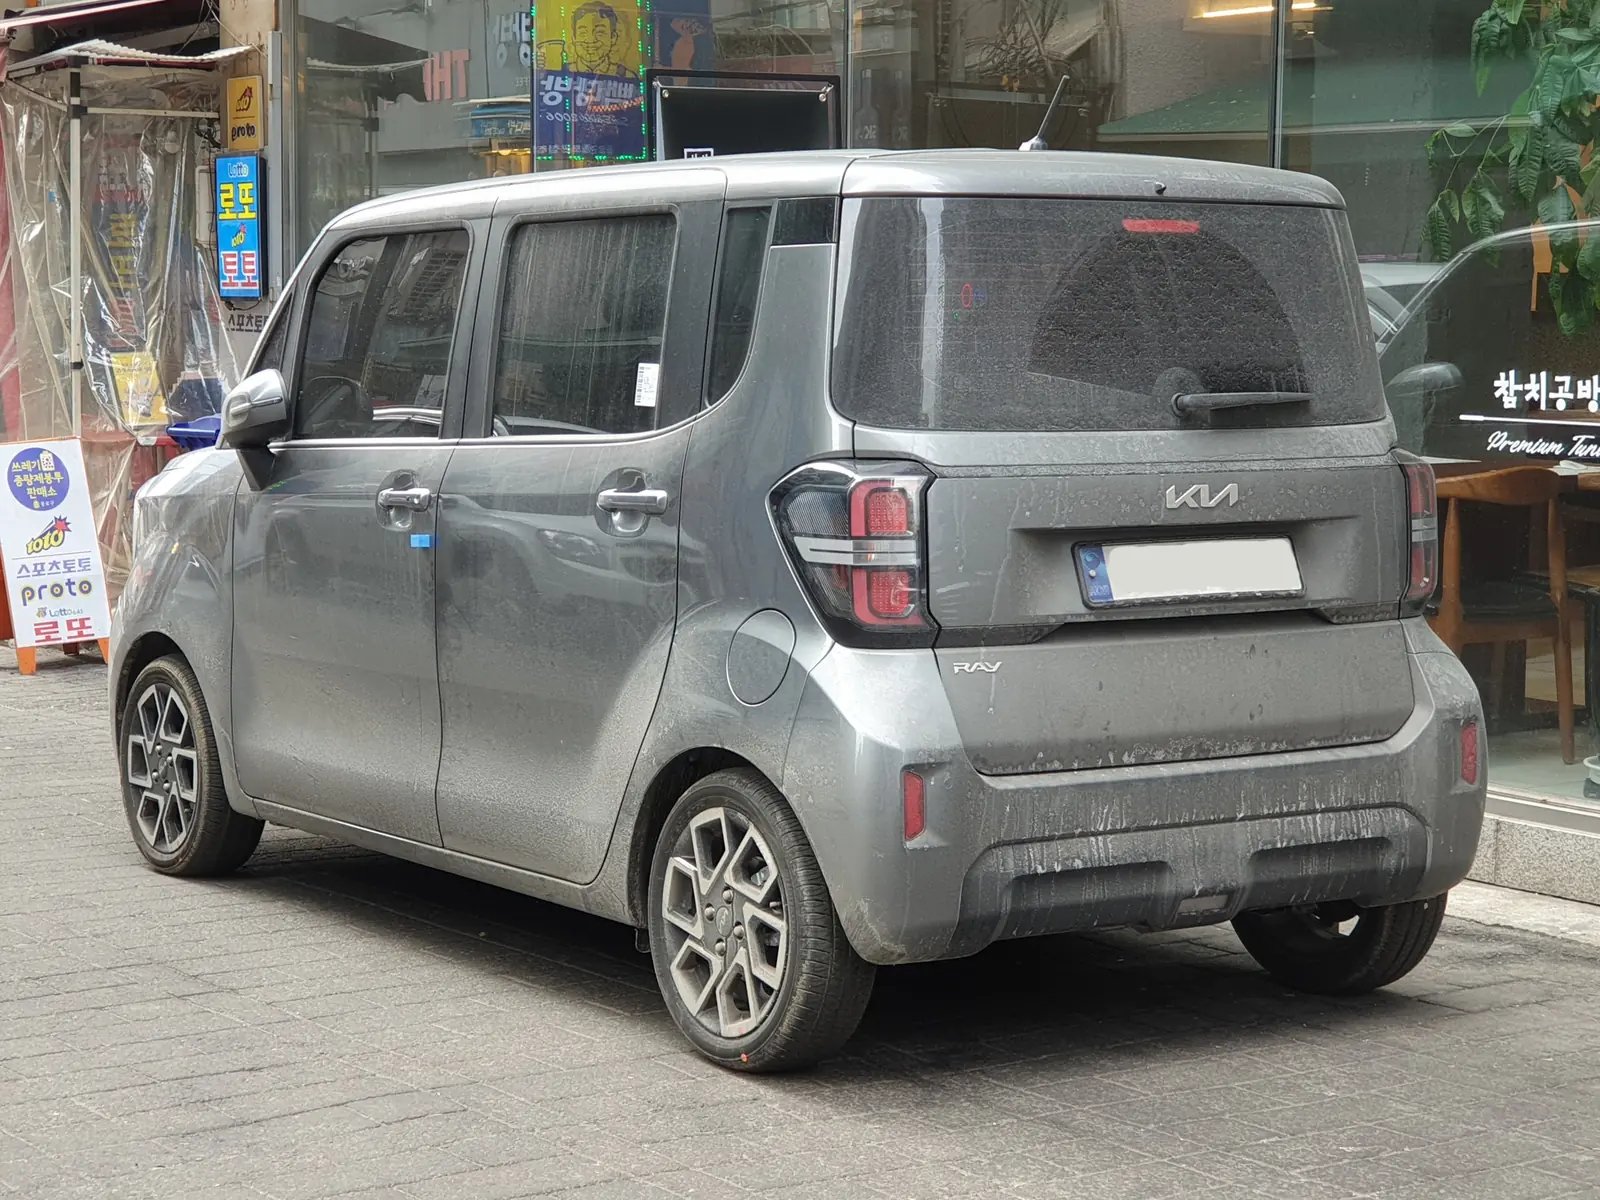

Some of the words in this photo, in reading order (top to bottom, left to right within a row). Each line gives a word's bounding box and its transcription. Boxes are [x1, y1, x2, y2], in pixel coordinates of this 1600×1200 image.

[231, 122, 257, 142] proto
[218, 182, 257, 220] 로또
[219, 251, 260, 289] 토토
[1493, 369, 1600, 413] 참치공방
[1486, 430, 1565, 456] Premium
[12, 460, 41, 472] 쓰레기
[14, 471, 64, 487] 종량제봉투
[27, 486, 58, 500] 판매소
[1166, 483, 1239, 509] KIA
[17, 557, 92, 579] 스포츠토토
[21, 578, 92, 607] proto
[34, 617, 95, 643] 로또
[953, 661, 1002, 675] RAY
